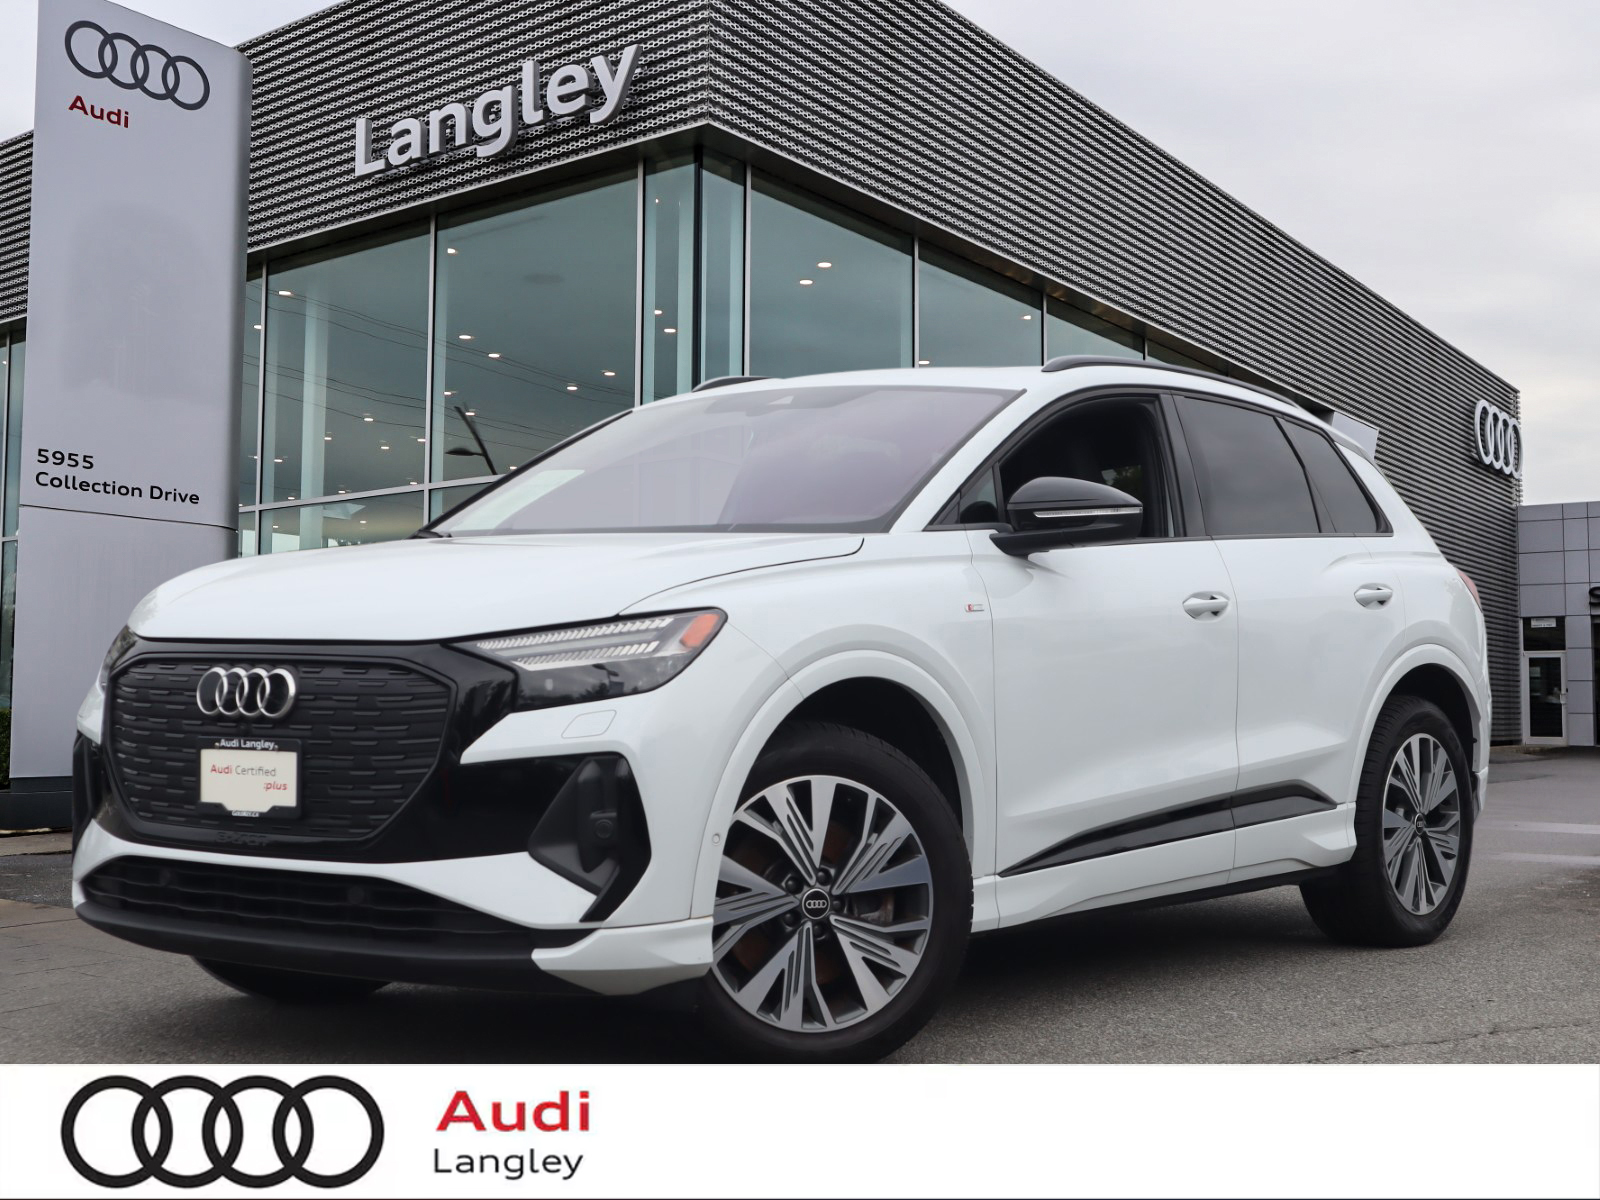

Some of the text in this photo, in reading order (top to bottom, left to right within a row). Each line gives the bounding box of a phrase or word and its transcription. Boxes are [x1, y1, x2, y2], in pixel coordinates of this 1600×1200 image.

[68, 94, 129, 128] Audi
[354, 44, 643, 177] Langley
[37, 448, 94, 469] 5955
[35, 471, 200, 504] Collection Drive
[219, 738, 275, 750] Audi Langley
[210, 764, 277, 777] Audi Certified
